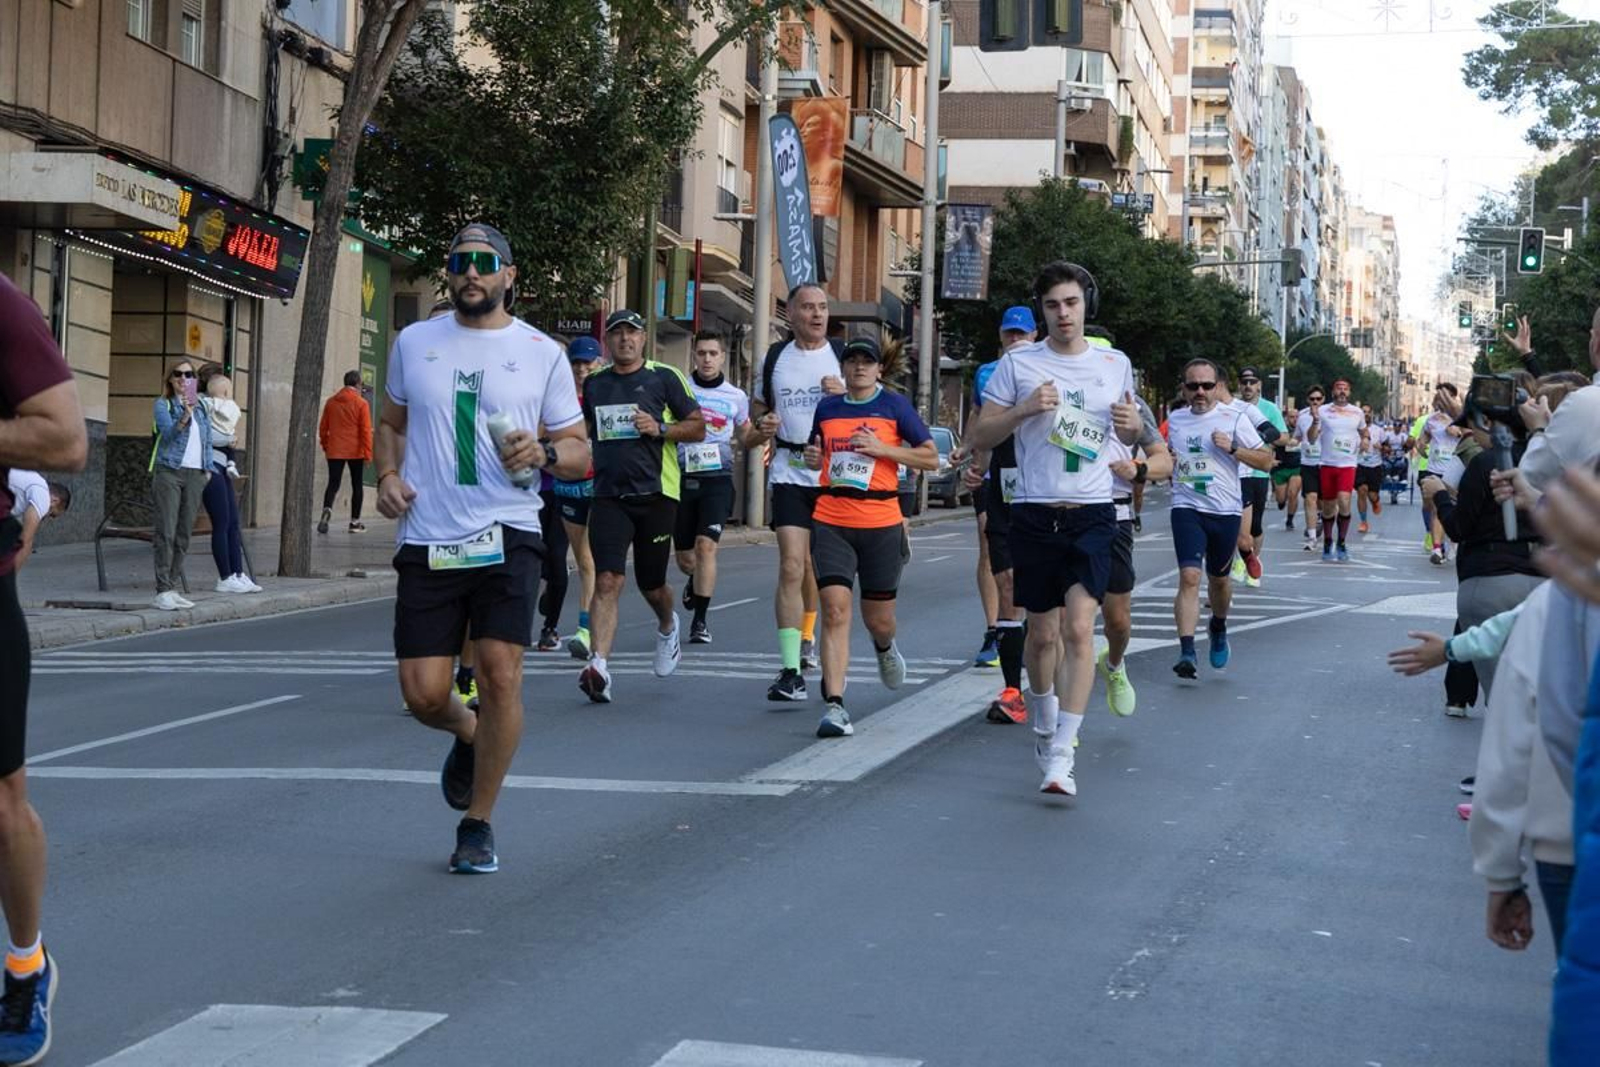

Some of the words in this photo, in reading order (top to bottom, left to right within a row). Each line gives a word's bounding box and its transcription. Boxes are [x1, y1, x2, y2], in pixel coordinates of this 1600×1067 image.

[227, 224, 279, 272] JOKER
[557, 320, 592, 329] KIABI
[1082, 427, 1105, 444] 633
[846, 463, 868, 475] 595
